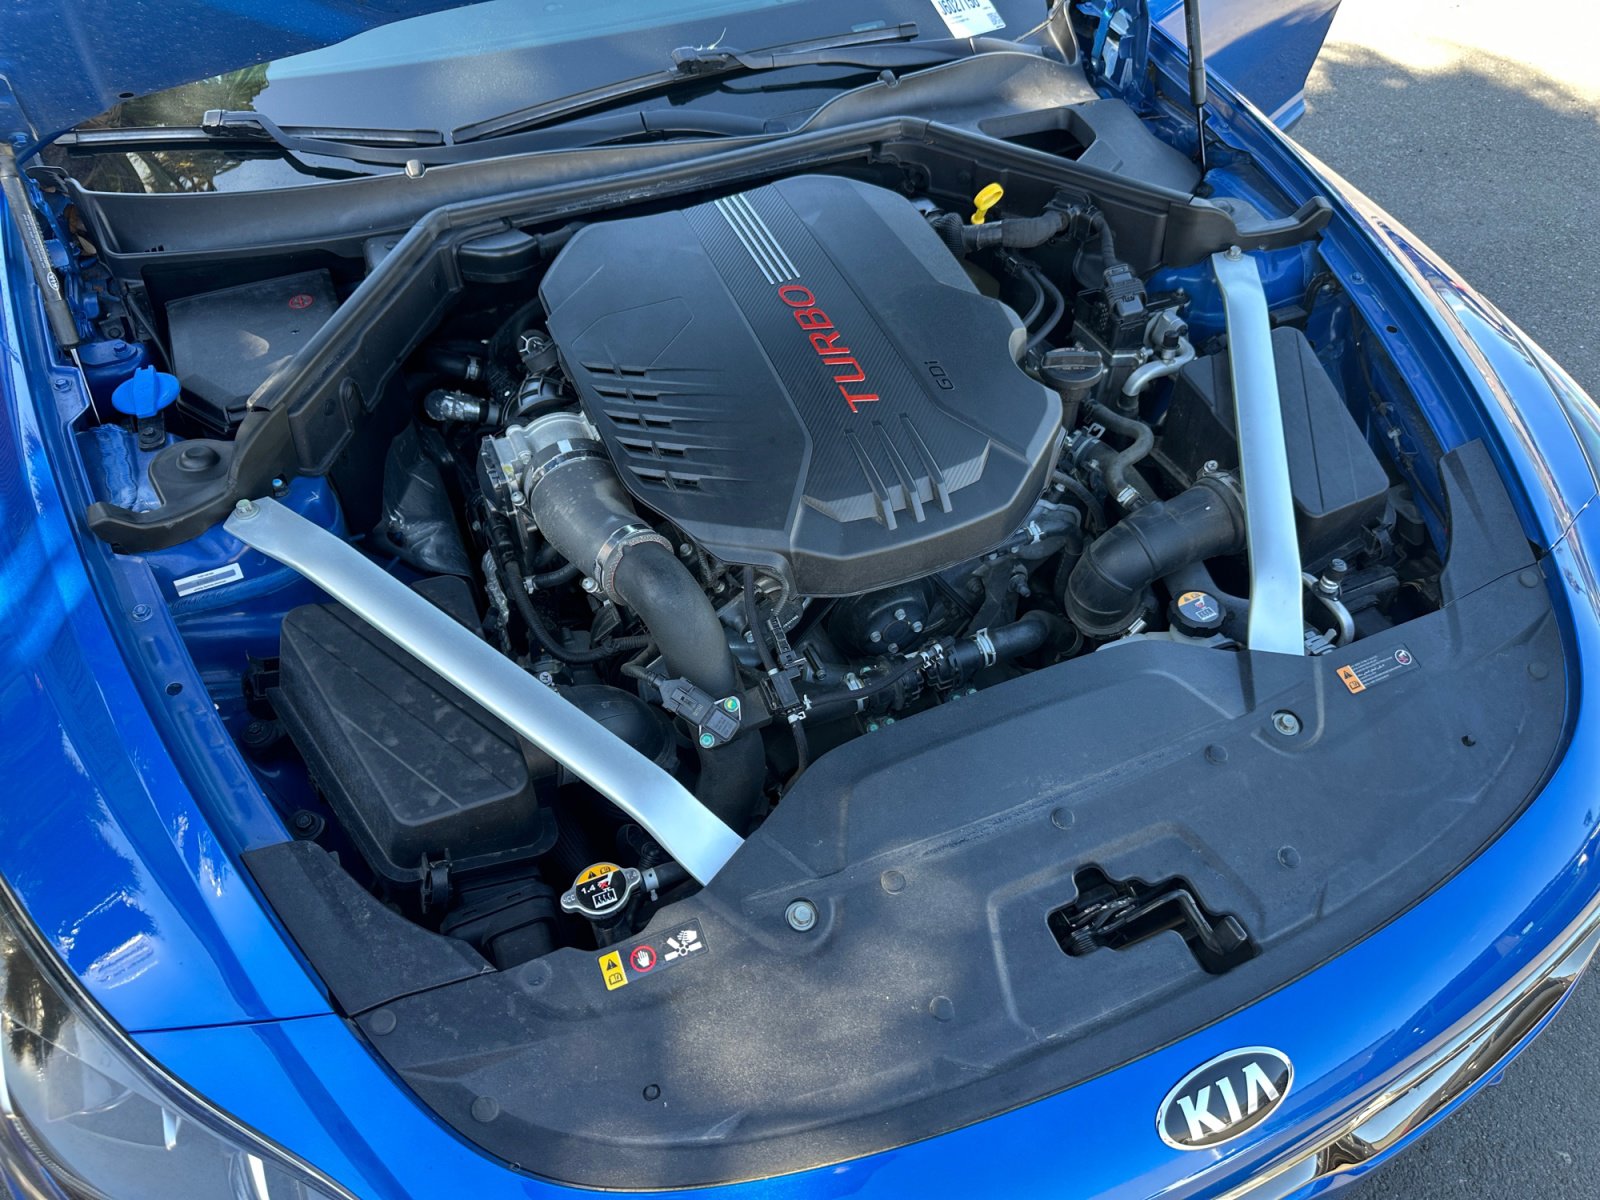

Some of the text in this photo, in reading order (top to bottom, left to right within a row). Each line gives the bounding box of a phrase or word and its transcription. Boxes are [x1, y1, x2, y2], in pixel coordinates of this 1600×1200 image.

[778, 285, 879, 413] TURBO
[581, 884, 596, 894] 1.4
[1176, 1062, 1280, 1141] KIA
